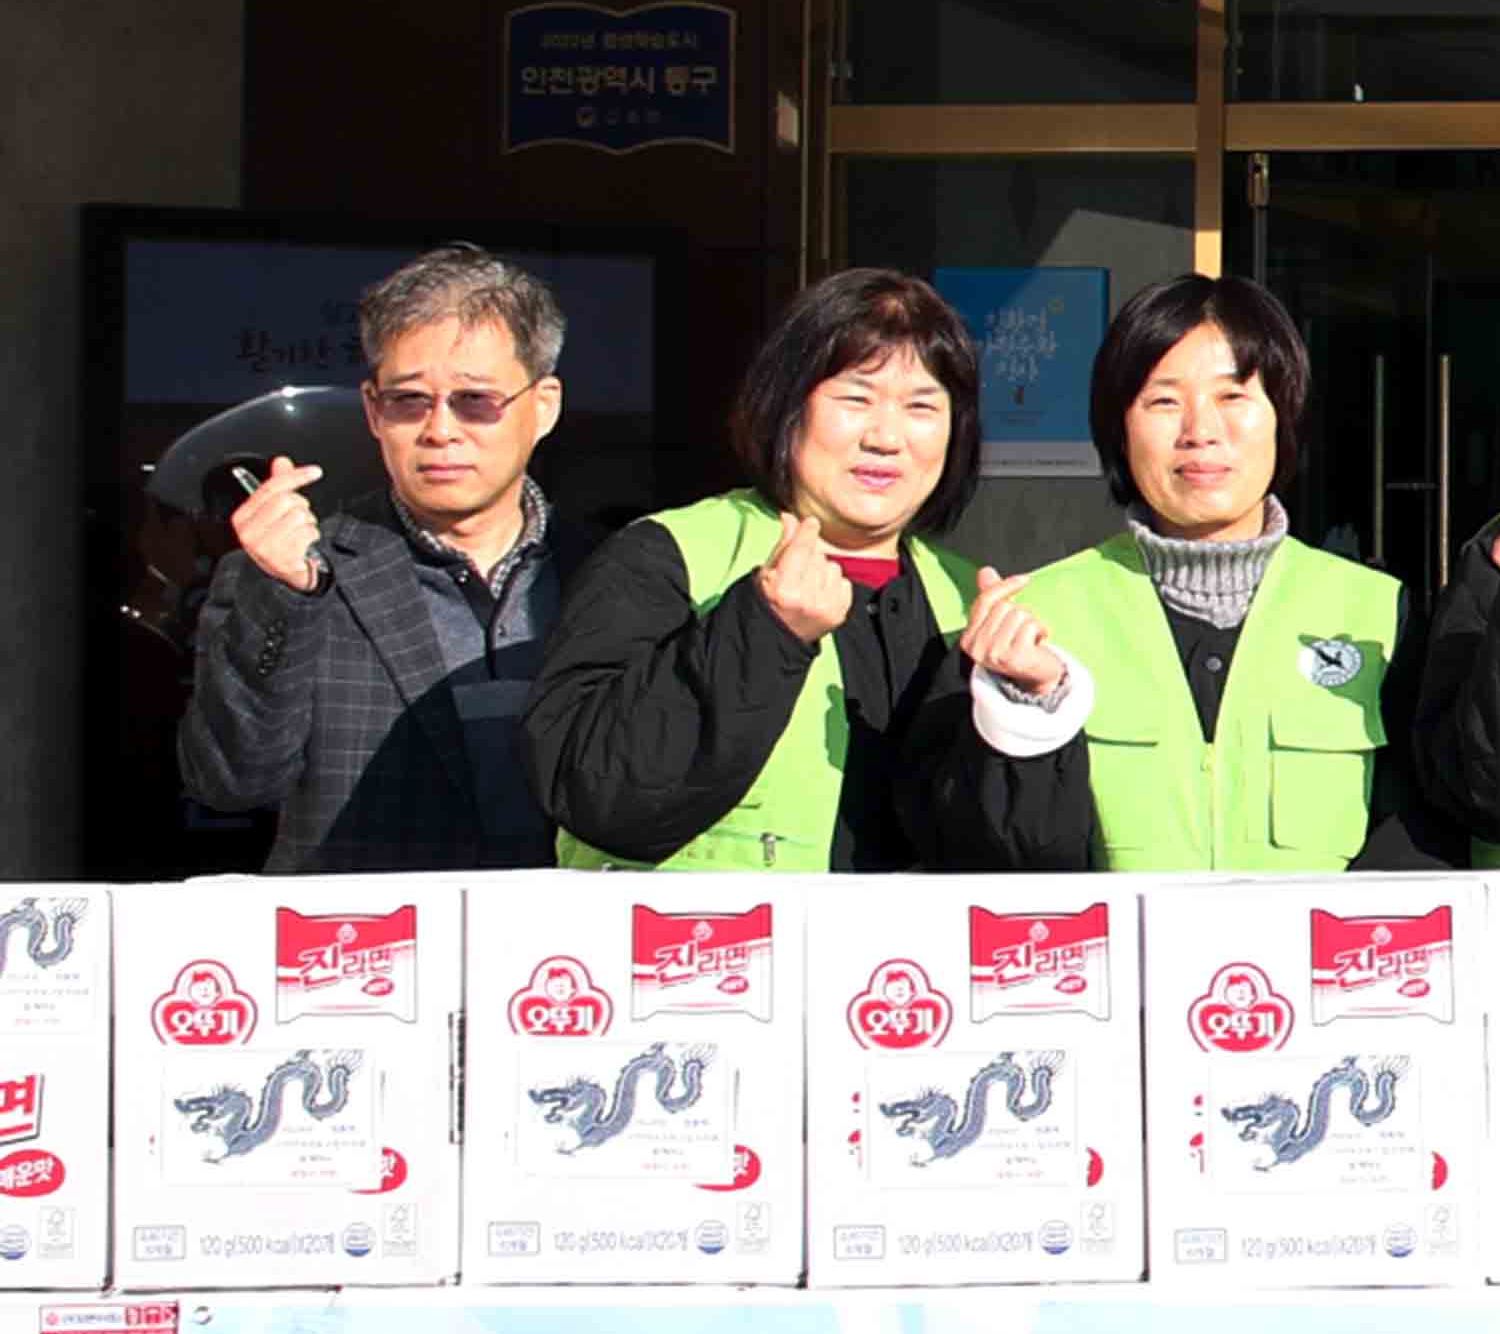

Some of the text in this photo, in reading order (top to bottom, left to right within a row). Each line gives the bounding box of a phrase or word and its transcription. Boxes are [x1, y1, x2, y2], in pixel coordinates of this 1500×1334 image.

[519, 65, 721, 97] 인천광역시 동구
[298, 945, 394, 986] 진라면
[653, 946, 751, 986] 진라면
[992, 944, 1089, 986] 진라면
[1334, 947, 1431, 987] 진라면
[171, 1008, 240, 1036] 오뚜기
[526, 1003, 594, 1035] 오뚜기
[866, 1006, 935, 1039] 오뚜기
[1207, 1008, 1276, 1042] 오뚜기
